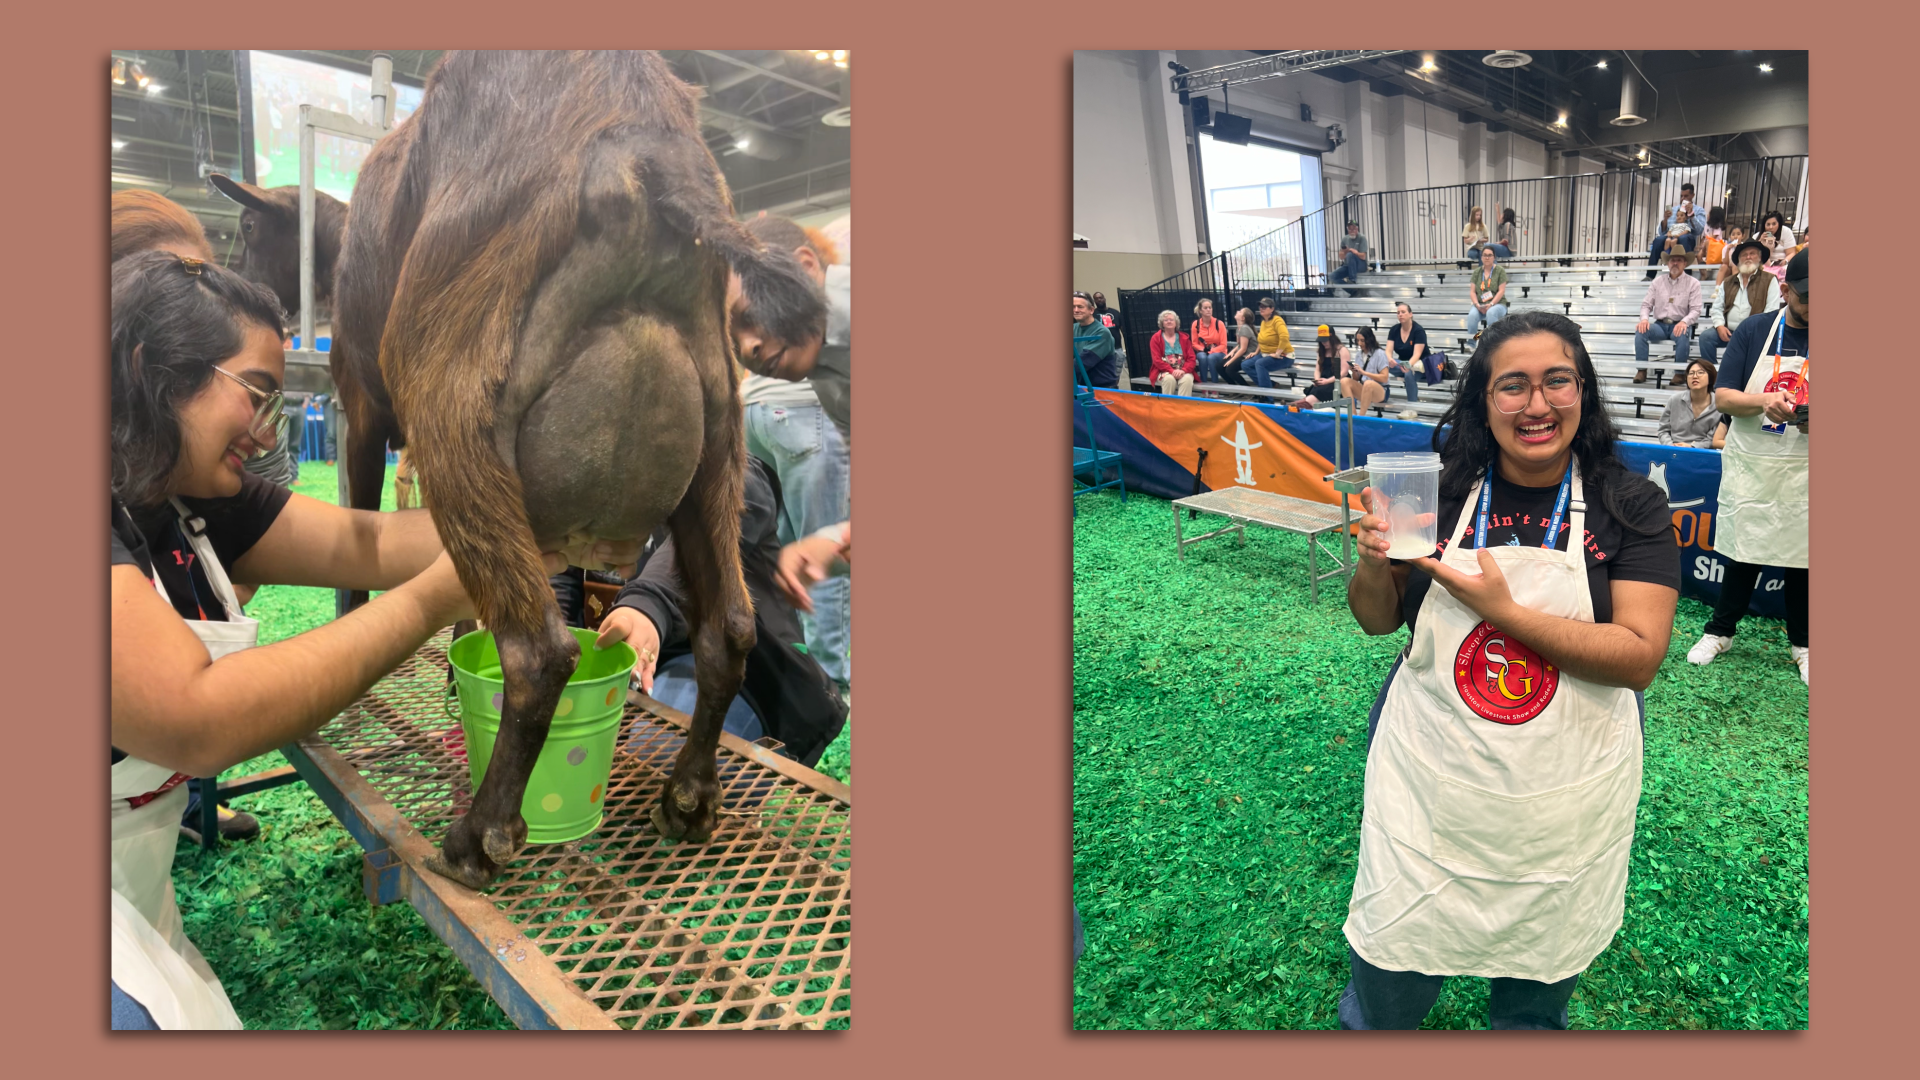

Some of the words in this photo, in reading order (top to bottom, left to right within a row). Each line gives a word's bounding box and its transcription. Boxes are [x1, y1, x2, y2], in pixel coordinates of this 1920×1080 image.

[1458, 636, 1480, 666] Sheep
[1462, 683, 1481, 708] Houston
[1480, 704, 1511, 720] Livestock
[1512, 711, 1530, 720] Show
[1530, 702, 1541, 713] and
